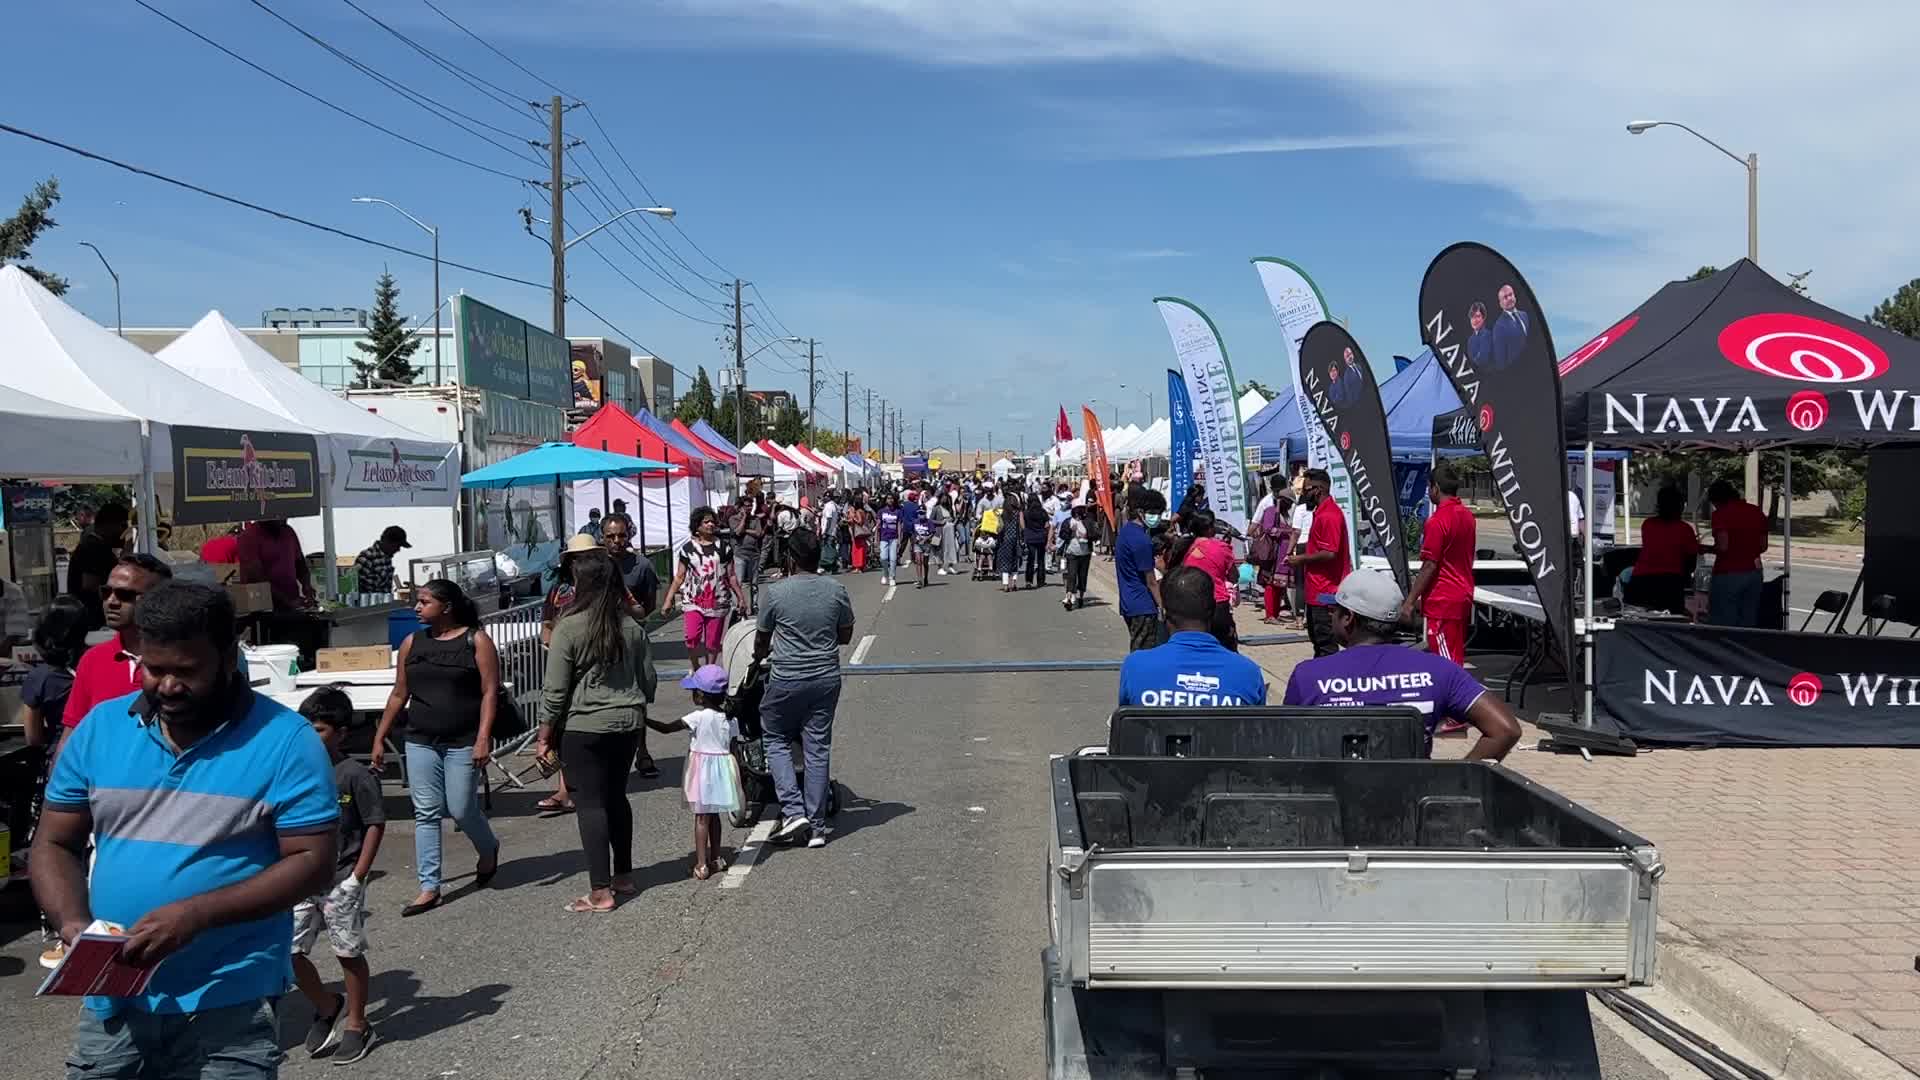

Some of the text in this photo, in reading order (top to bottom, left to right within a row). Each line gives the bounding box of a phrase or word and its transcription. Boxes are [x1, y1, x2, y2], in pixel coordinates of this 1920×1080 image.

[1449, 415, 1476, 445] NAVA
[1602, 392, 1769, 434] NAVA
[1305, 367, 1396, 547] NAVA WILSON
[1426, 310, 1556, 580] NAVA WILSON
[1317, 672, 1434, 694] VOLUNTEER
[1642, 669, 1774, 706] NAVA
